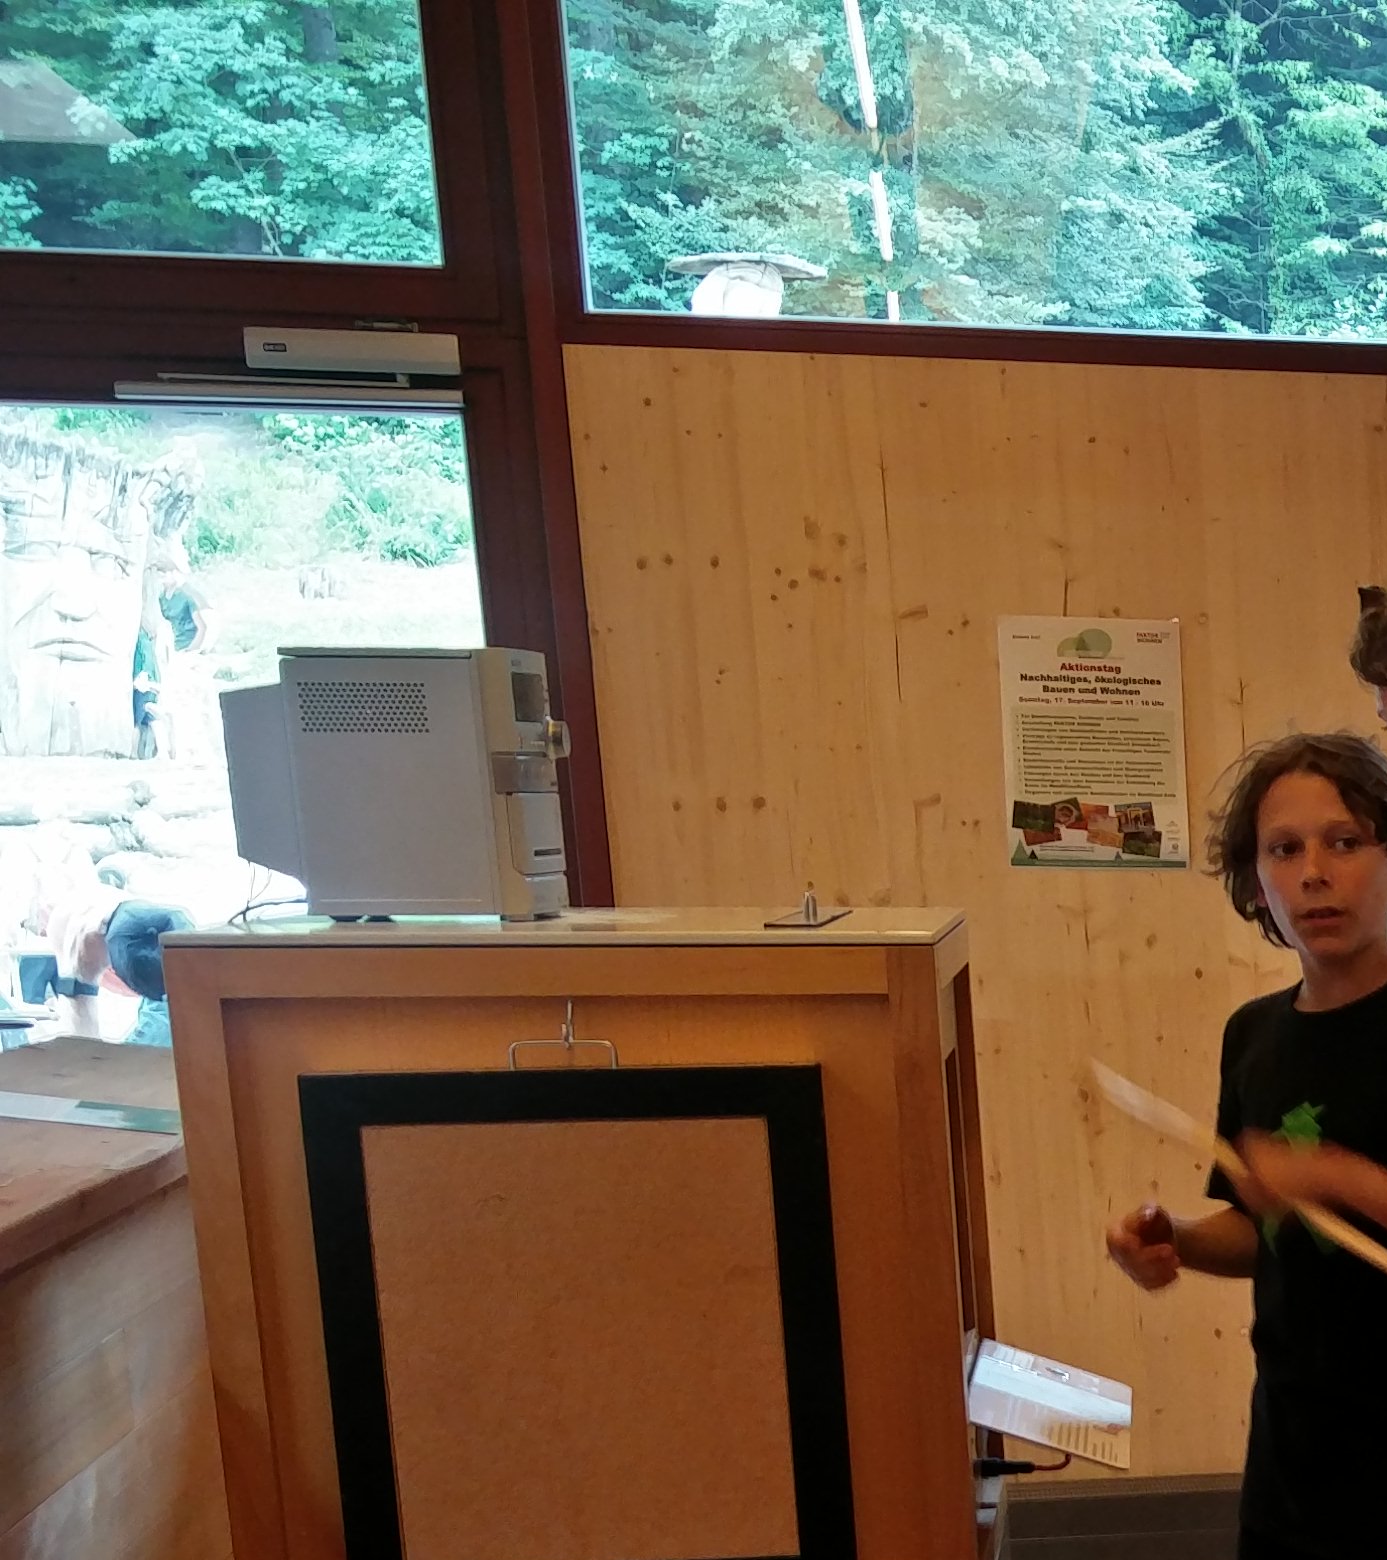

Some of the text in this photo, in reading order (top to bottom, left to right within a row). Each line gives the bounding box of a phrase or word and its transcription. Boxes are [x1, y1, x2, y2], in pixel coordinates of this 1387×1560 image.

[1060, 663, 1121, 674] Aktionstag
[1020, 674, 1161, 686] Nachhaltiges, ökologisches
[1042, 685, 1075, 694] Bauen
[1100, 687, 1140, 695] Wohnen
